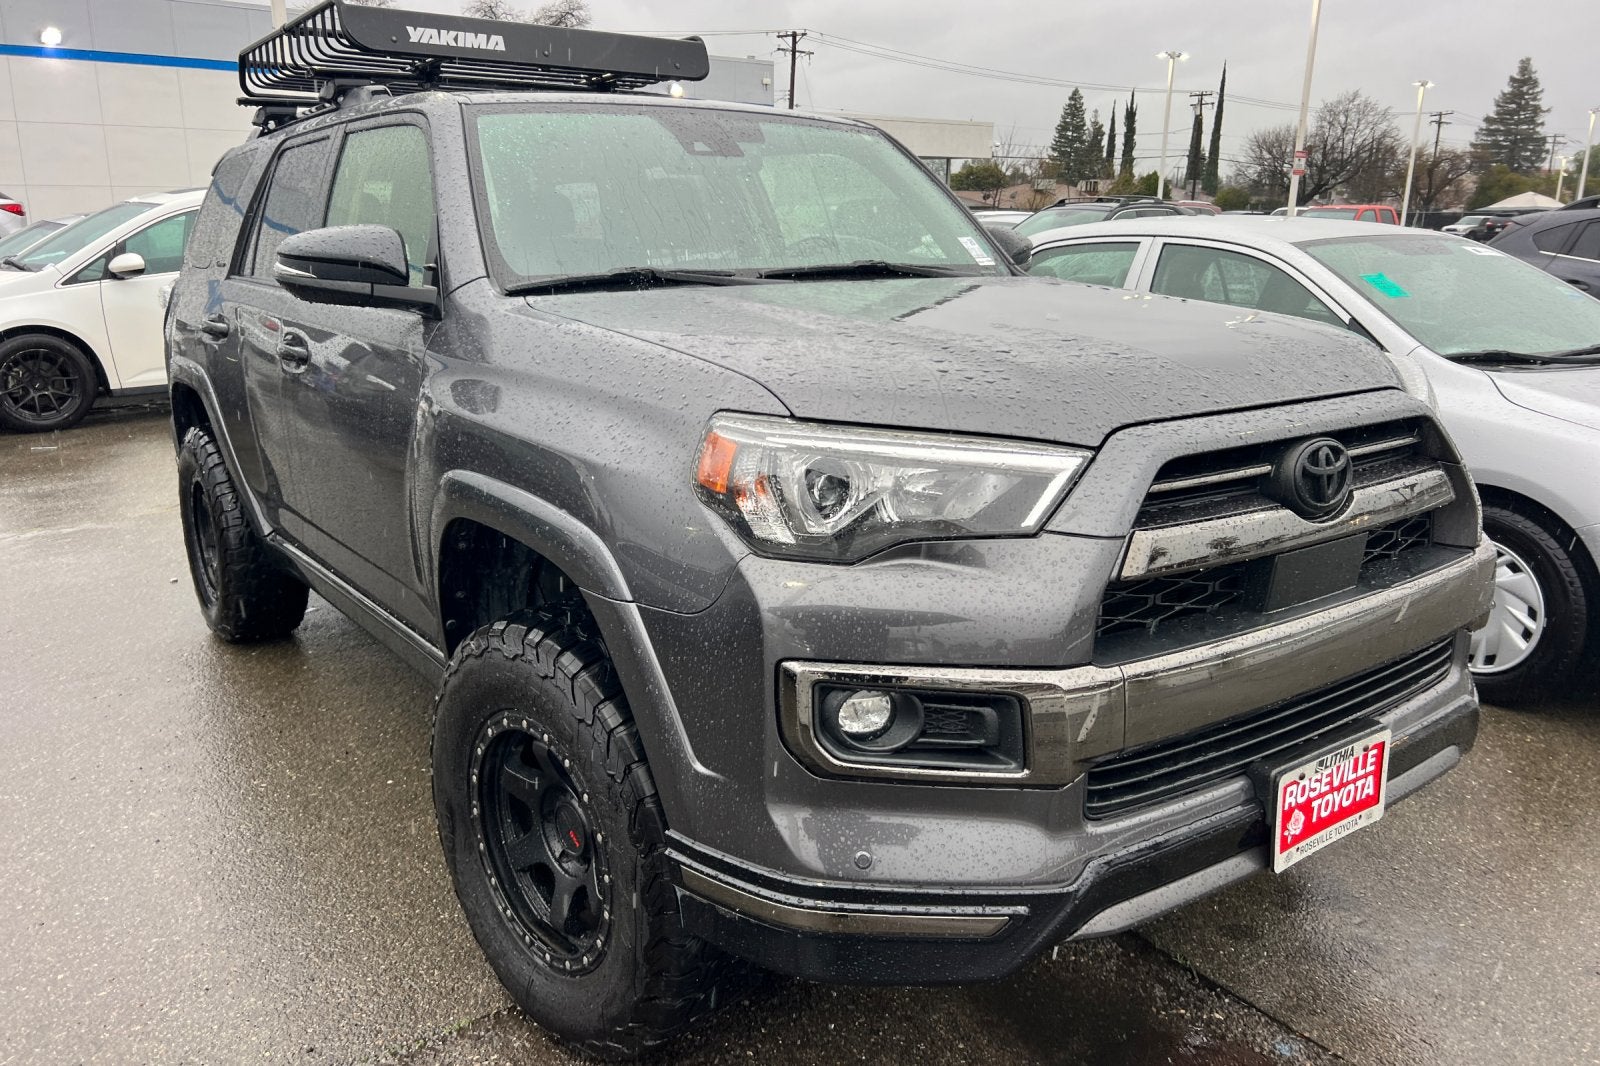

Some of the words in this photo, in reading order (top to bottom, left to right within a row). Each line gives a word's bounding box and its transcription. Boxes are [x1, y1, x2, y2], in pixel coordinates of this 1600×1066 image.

[405, 25, 506, 51] YAKIMA
[1324, 745, 1355, 769] LITHIA
[1284, 748, 1378, 811] ROSEVILLE
[1311, 774, 1375, 823] TOYOTA
[1300, 832, 1333, 854] ROSEVILLE
[1334, 818, 1359, 836] TOYOTA
